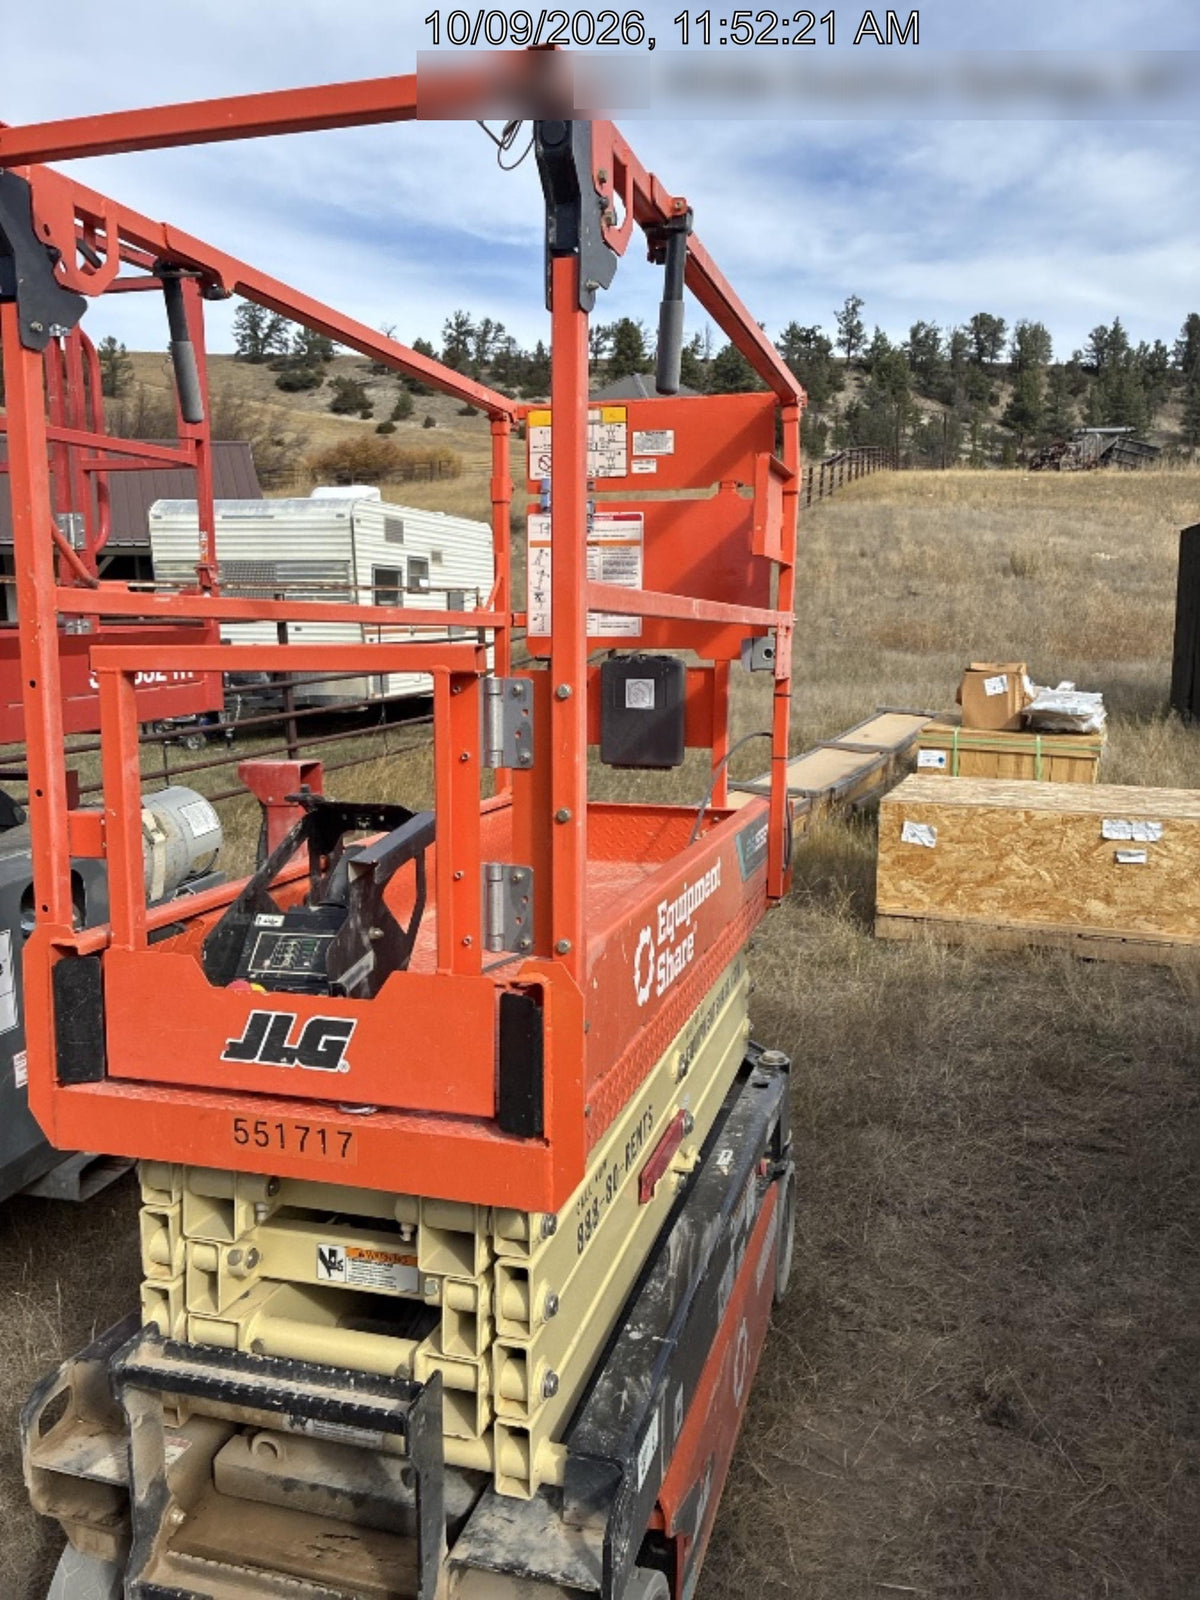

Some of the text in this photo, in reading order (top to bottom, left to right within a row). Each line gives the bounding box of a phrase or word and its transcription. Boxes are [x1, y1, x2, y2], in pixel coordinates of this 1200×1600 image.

[657, 856, 721, 946] Equipment
[656, 932, 695, 997] Share
[220, 1009, 358, 1073] JLG
[232, 1117, 353, 1158] 551717
